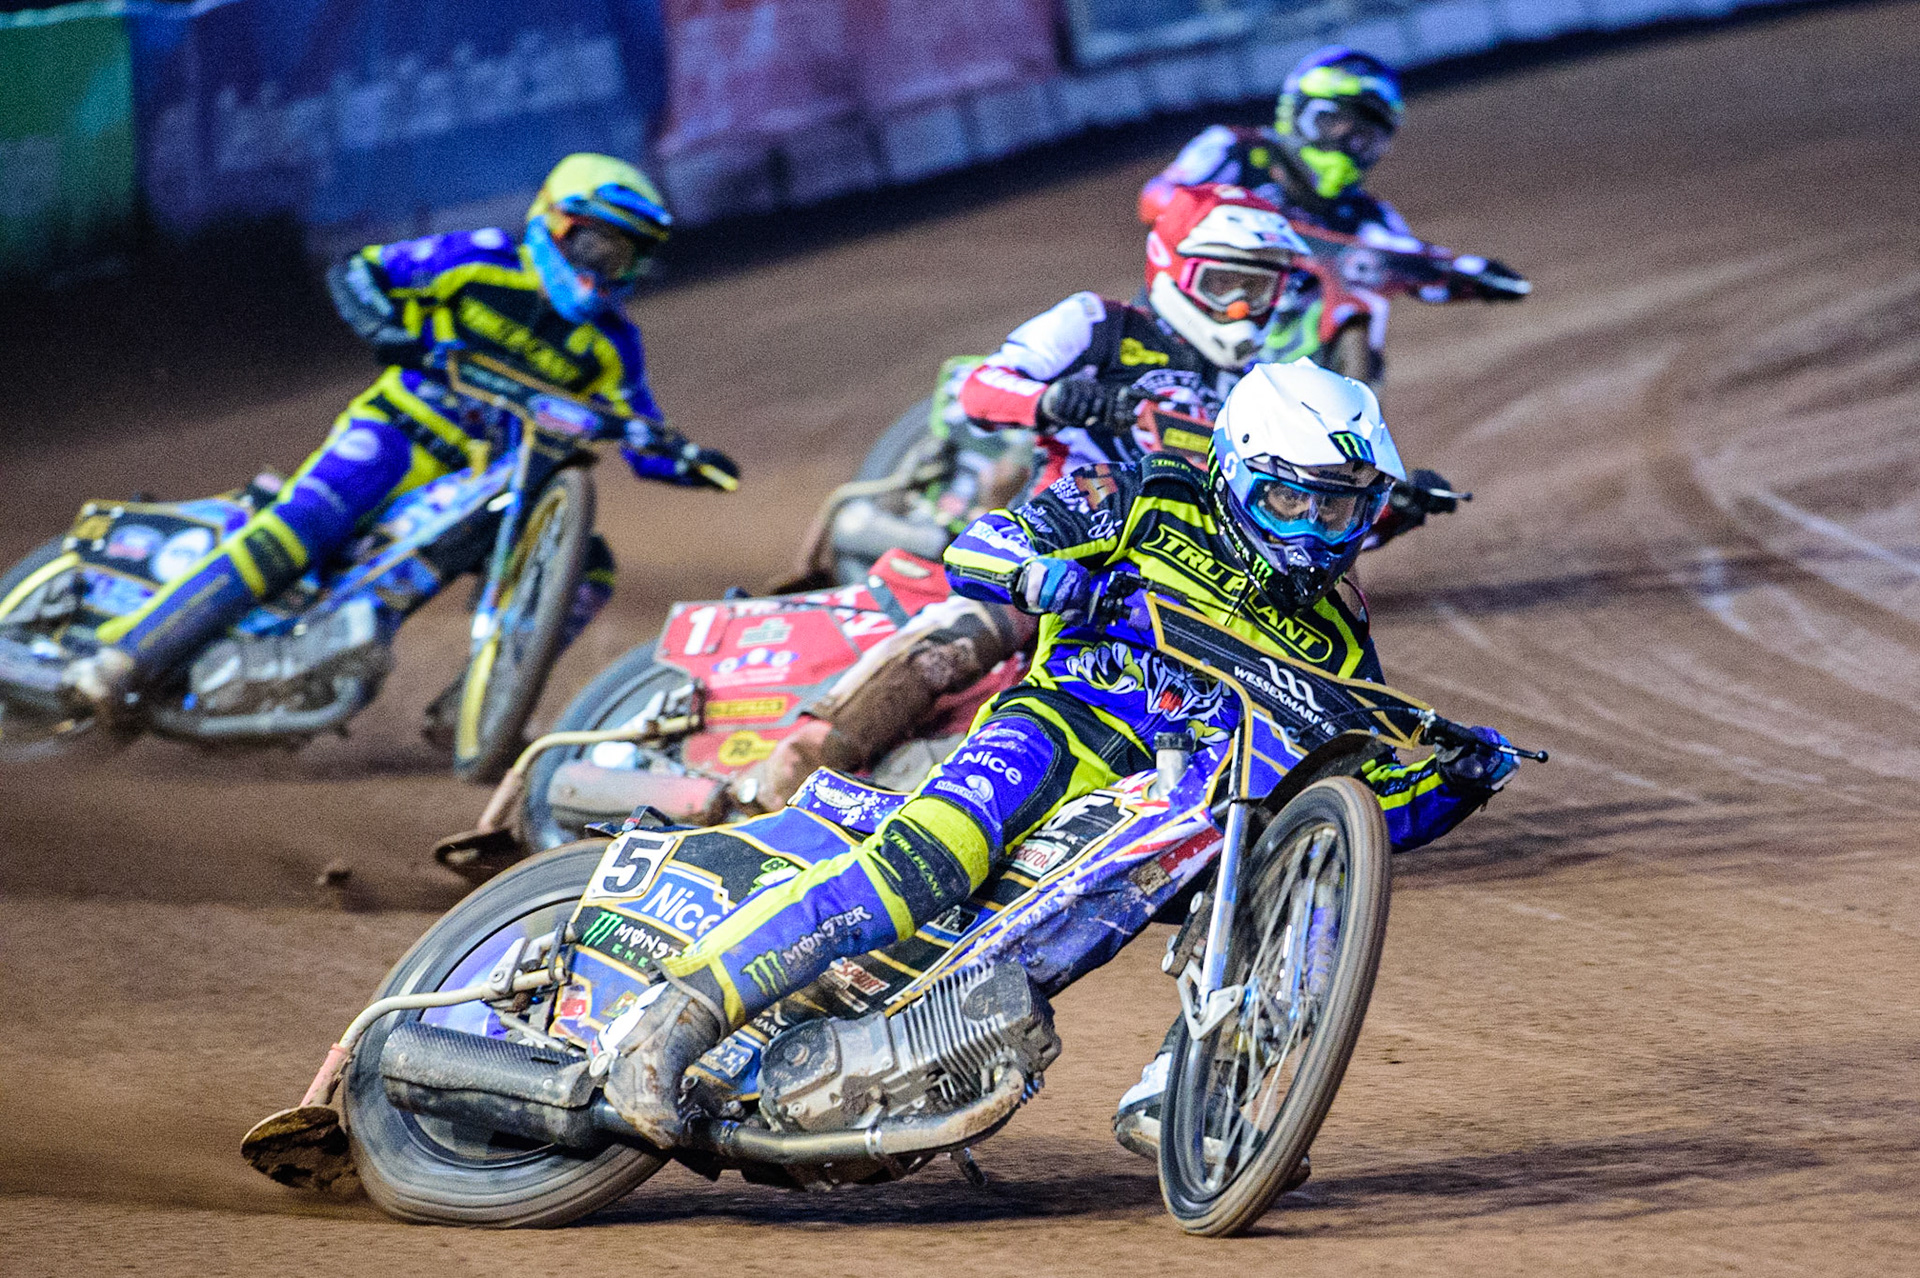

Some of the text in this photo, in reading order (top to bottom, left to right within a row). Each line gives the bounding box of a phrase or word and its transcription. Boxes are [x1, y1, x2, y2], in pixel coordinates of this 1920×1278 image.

[1162, 534, 1322, 652] TRU PLANT
[684, 606, 718, 656] 1
[603, 836, 665, 893] 5
[611, 943, 649, 968] ENE
[614, 923, 682, 960] MONST
